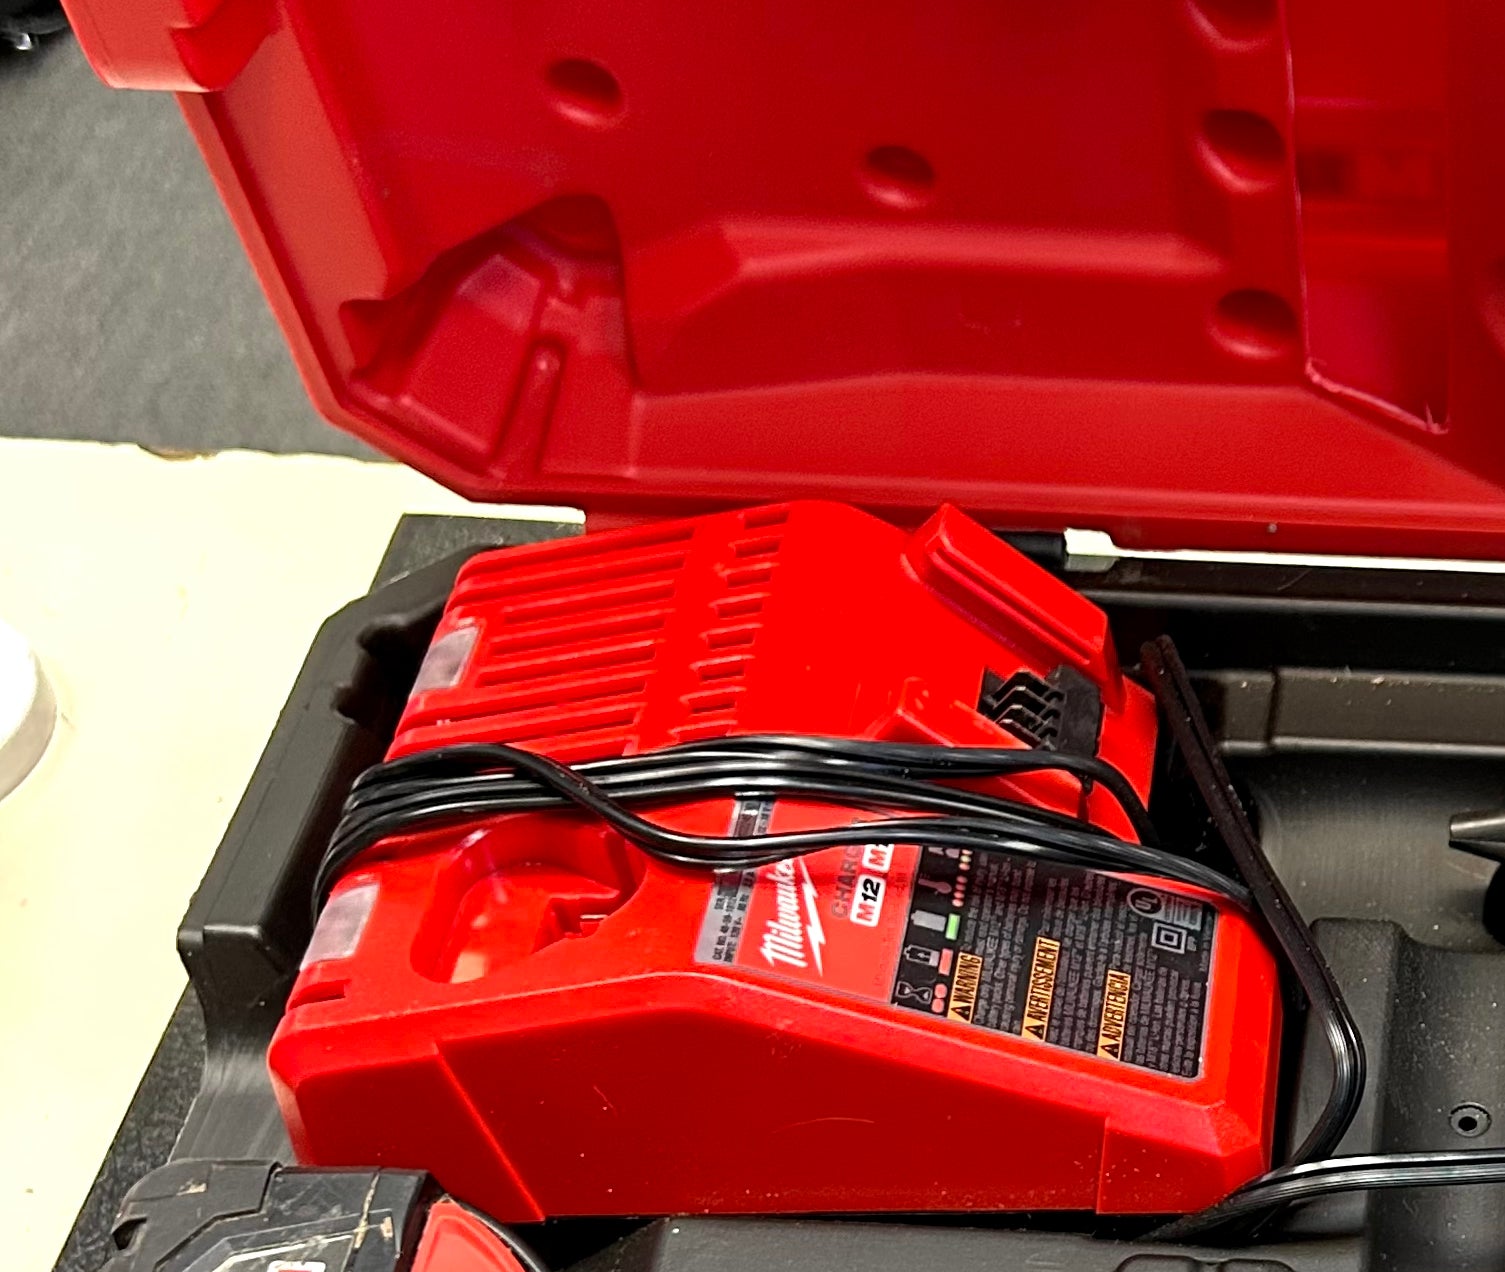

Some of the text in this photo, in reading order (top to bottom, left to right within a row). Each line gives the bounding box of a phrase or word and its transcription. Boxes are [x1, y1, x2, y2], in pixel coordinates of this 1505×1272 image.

[760, 857, 808, 968] Milwauke
[856, 878, 881, 922] M12
[953, 954, 982, 1005] WARNING
[1027, 938, 1058, 1023] AVERTISSEMENT
[1101, 972, 1130, 1043] ADVERTENCIA
